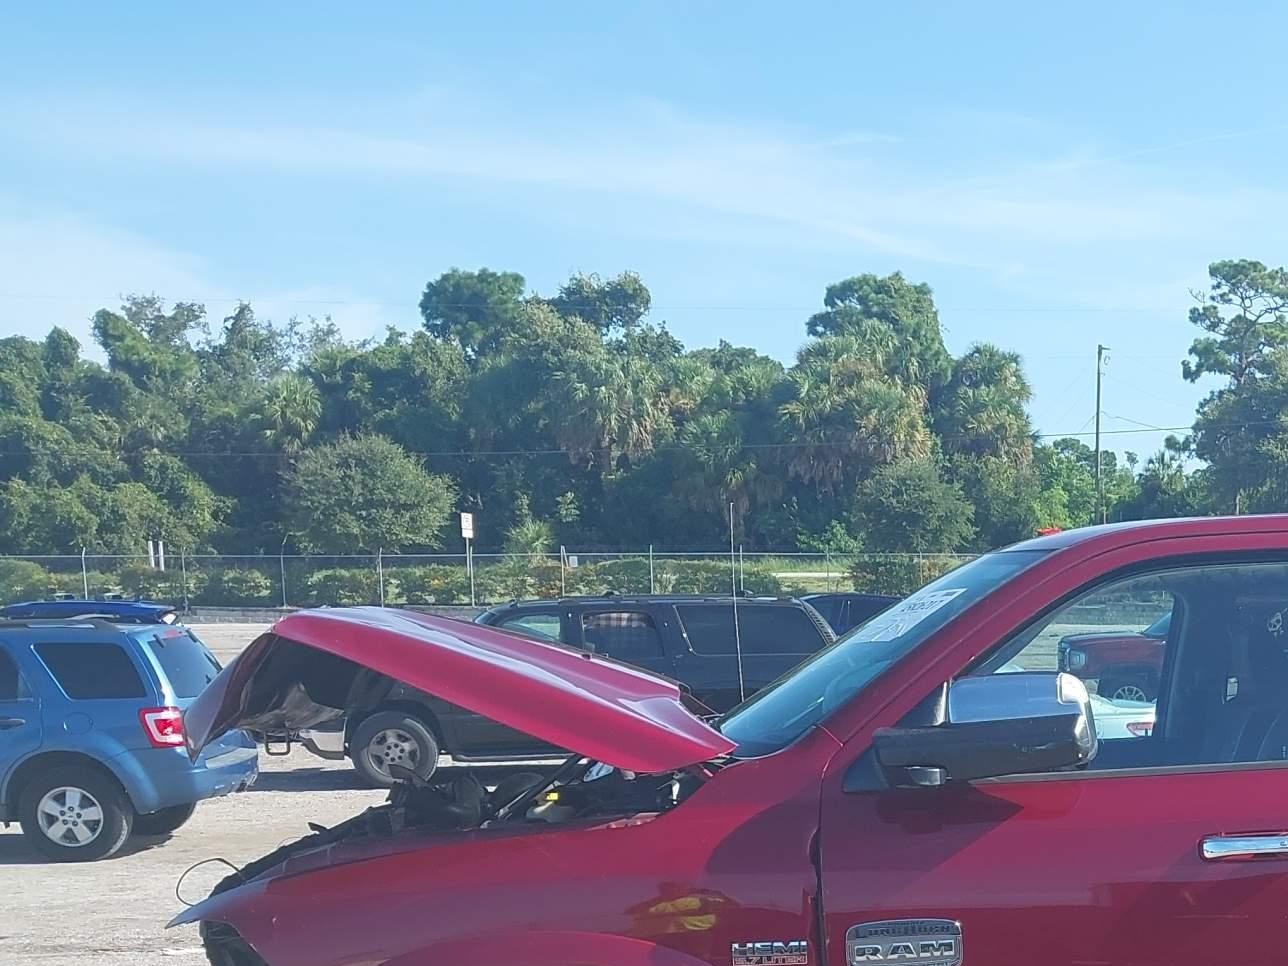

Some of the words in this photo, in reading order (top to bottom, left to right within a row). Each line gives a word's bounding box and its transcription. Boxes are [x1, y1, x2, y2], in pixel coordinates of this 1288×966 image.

[732, 941, 808, 956] HEMI
[855, 940, 955, 961] RAM
[735, 957, 761, 965] 5.7
[763, 955, 806, 964] LITER
